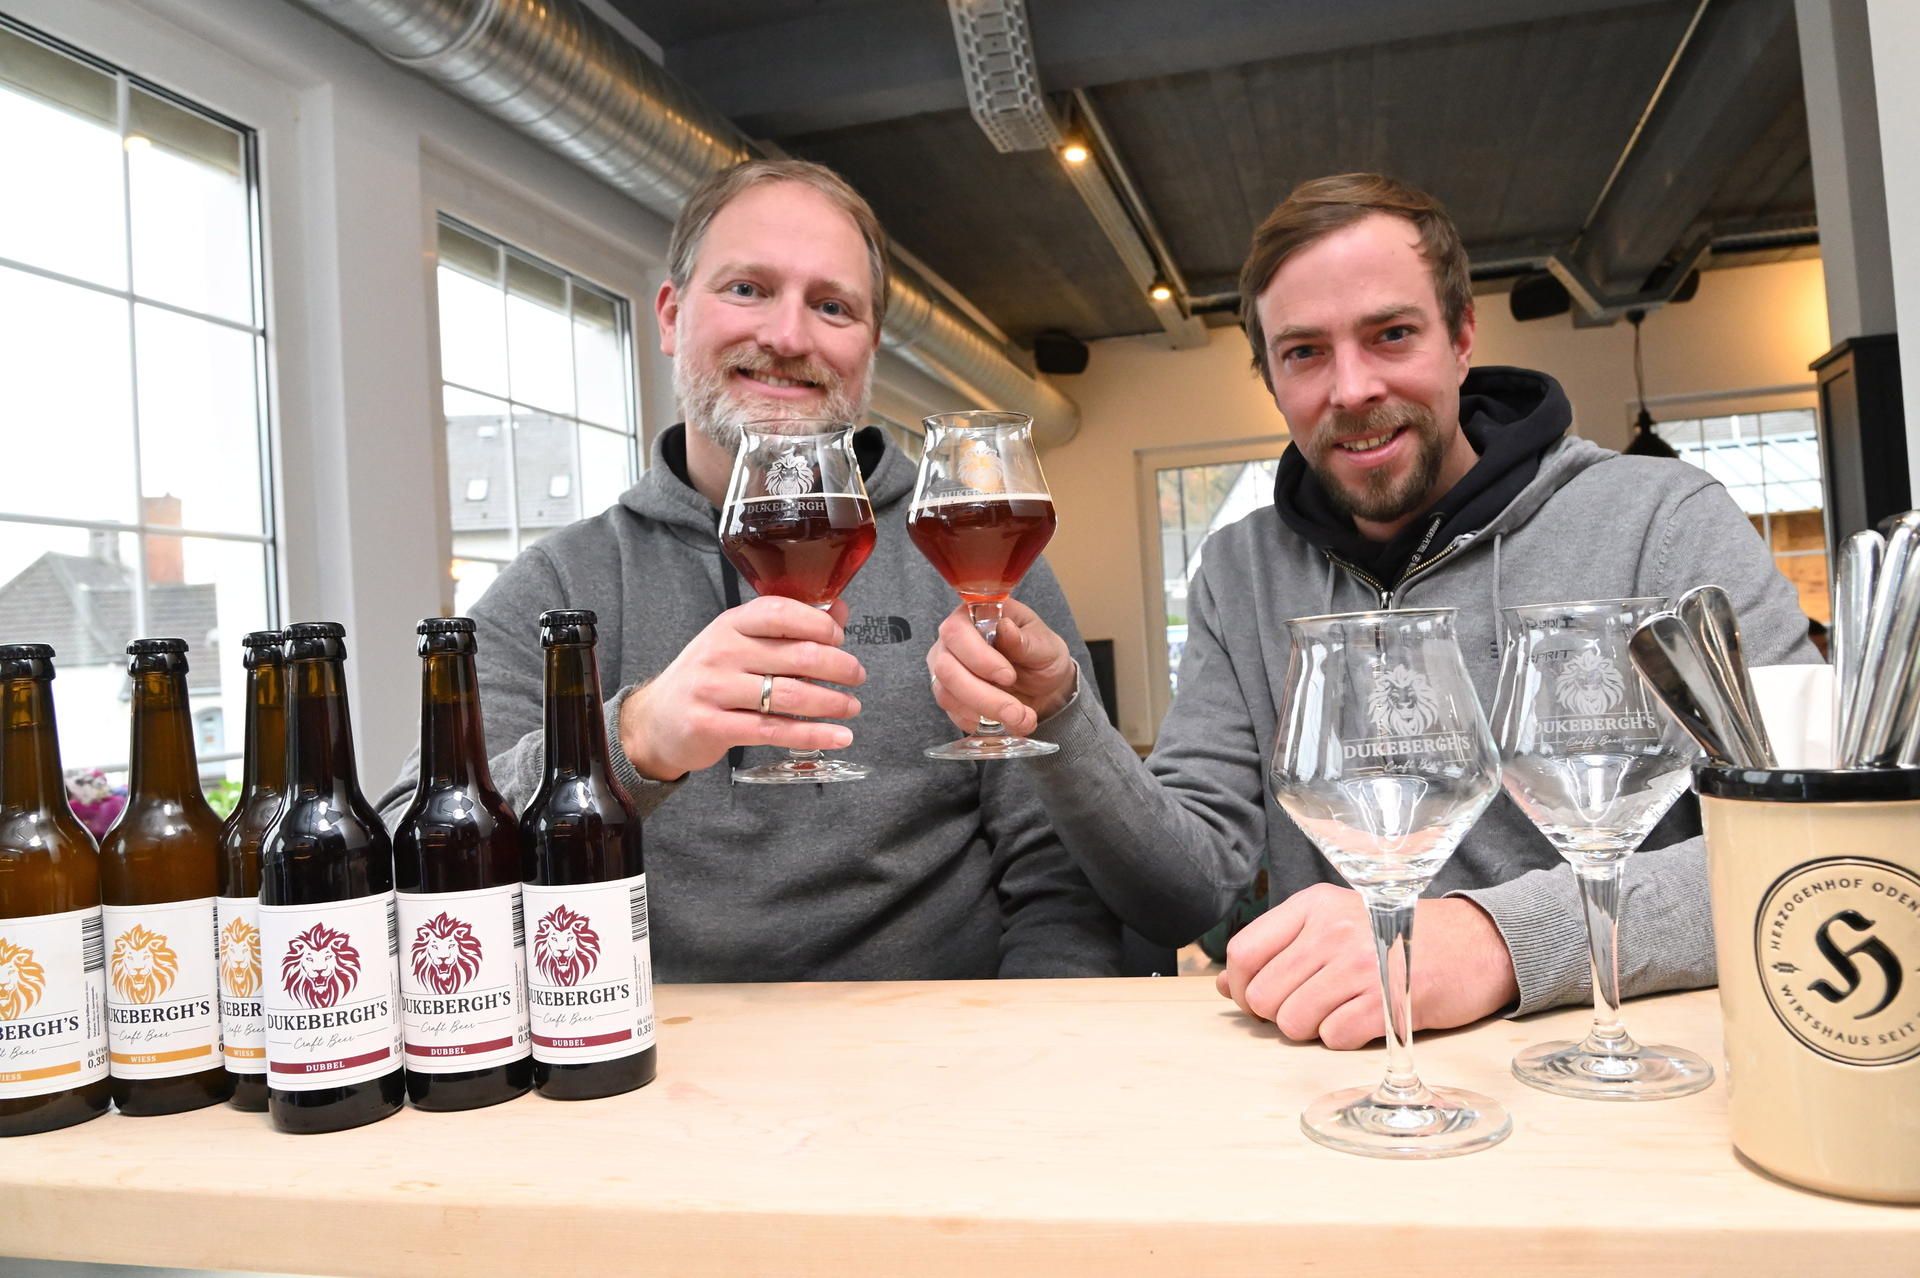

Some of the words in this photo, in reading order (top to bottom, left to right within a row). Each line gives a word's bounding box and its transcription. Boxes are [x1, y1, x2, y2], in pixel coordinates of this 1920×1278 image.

[862, 615, 887, 625] THE
[844, 624, 889, 637] NORTH
[858, 634, 889, 645] FACE
[1344, 734, 1470, 759] DUKEBERGH'S
[1566, 736, 1596, 748] Craft
[1771, 878, 1864, 951] HERZOGENHOF
[1872, 881, 1920, 918] ODEN
[529, 984, 629, 1006] UKEBERGH'S
[109, 1001, 210, 1023] UKEBERGH'S
[267, 1001, 388, 1030] DUKEBERGH'S
[543, 1013, 567, 1028] Craft
[569, 1011, 594, 1025] Beer
[1781, 984, 1870, 1046] WIRTSHAUS
[1878, 1021, 1916, 1045] SEIT
[420, 1021, 447, 1036] Craft
[449, 1020, 475, 1032] Beer
[119, 1030, 143, 1044] Craft
[145, 1030, 170, 1041] Beer
[294, 1037, 323, 1052] Craft
[326, 1033, 354, 1047] Beer
[552, 1039, 586, 1047] DUBBEL
[10, 1045, 37, 1060] Beer
[431, 1047, 467, 1056] DUBBEL
[130, 1055, 157, 1064] WIESS
[306, 1061, 345, 1072] DUBBEL
